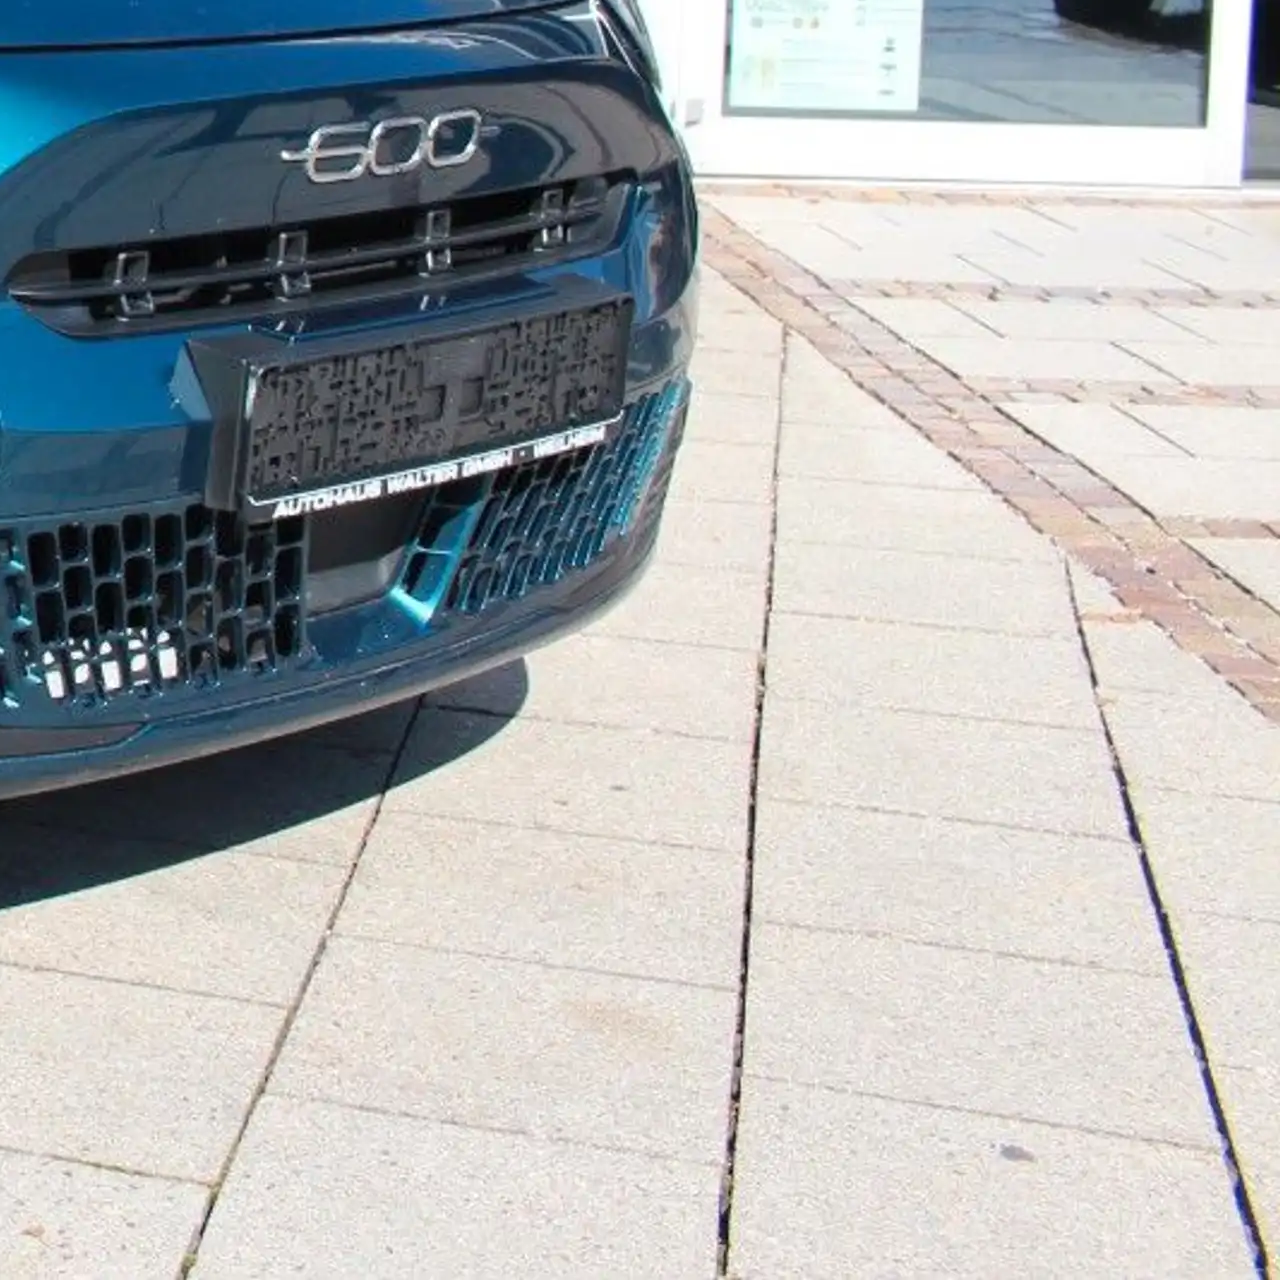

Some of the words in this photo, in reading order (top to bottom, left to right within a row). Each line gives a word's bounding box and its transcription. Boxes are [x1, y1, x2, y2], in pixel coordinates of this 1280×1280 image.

[294, 109, 490, 184] 600
[271, 478, 383, 520] AUTOHAUS
[386, 461, 458, 496] WALTER
